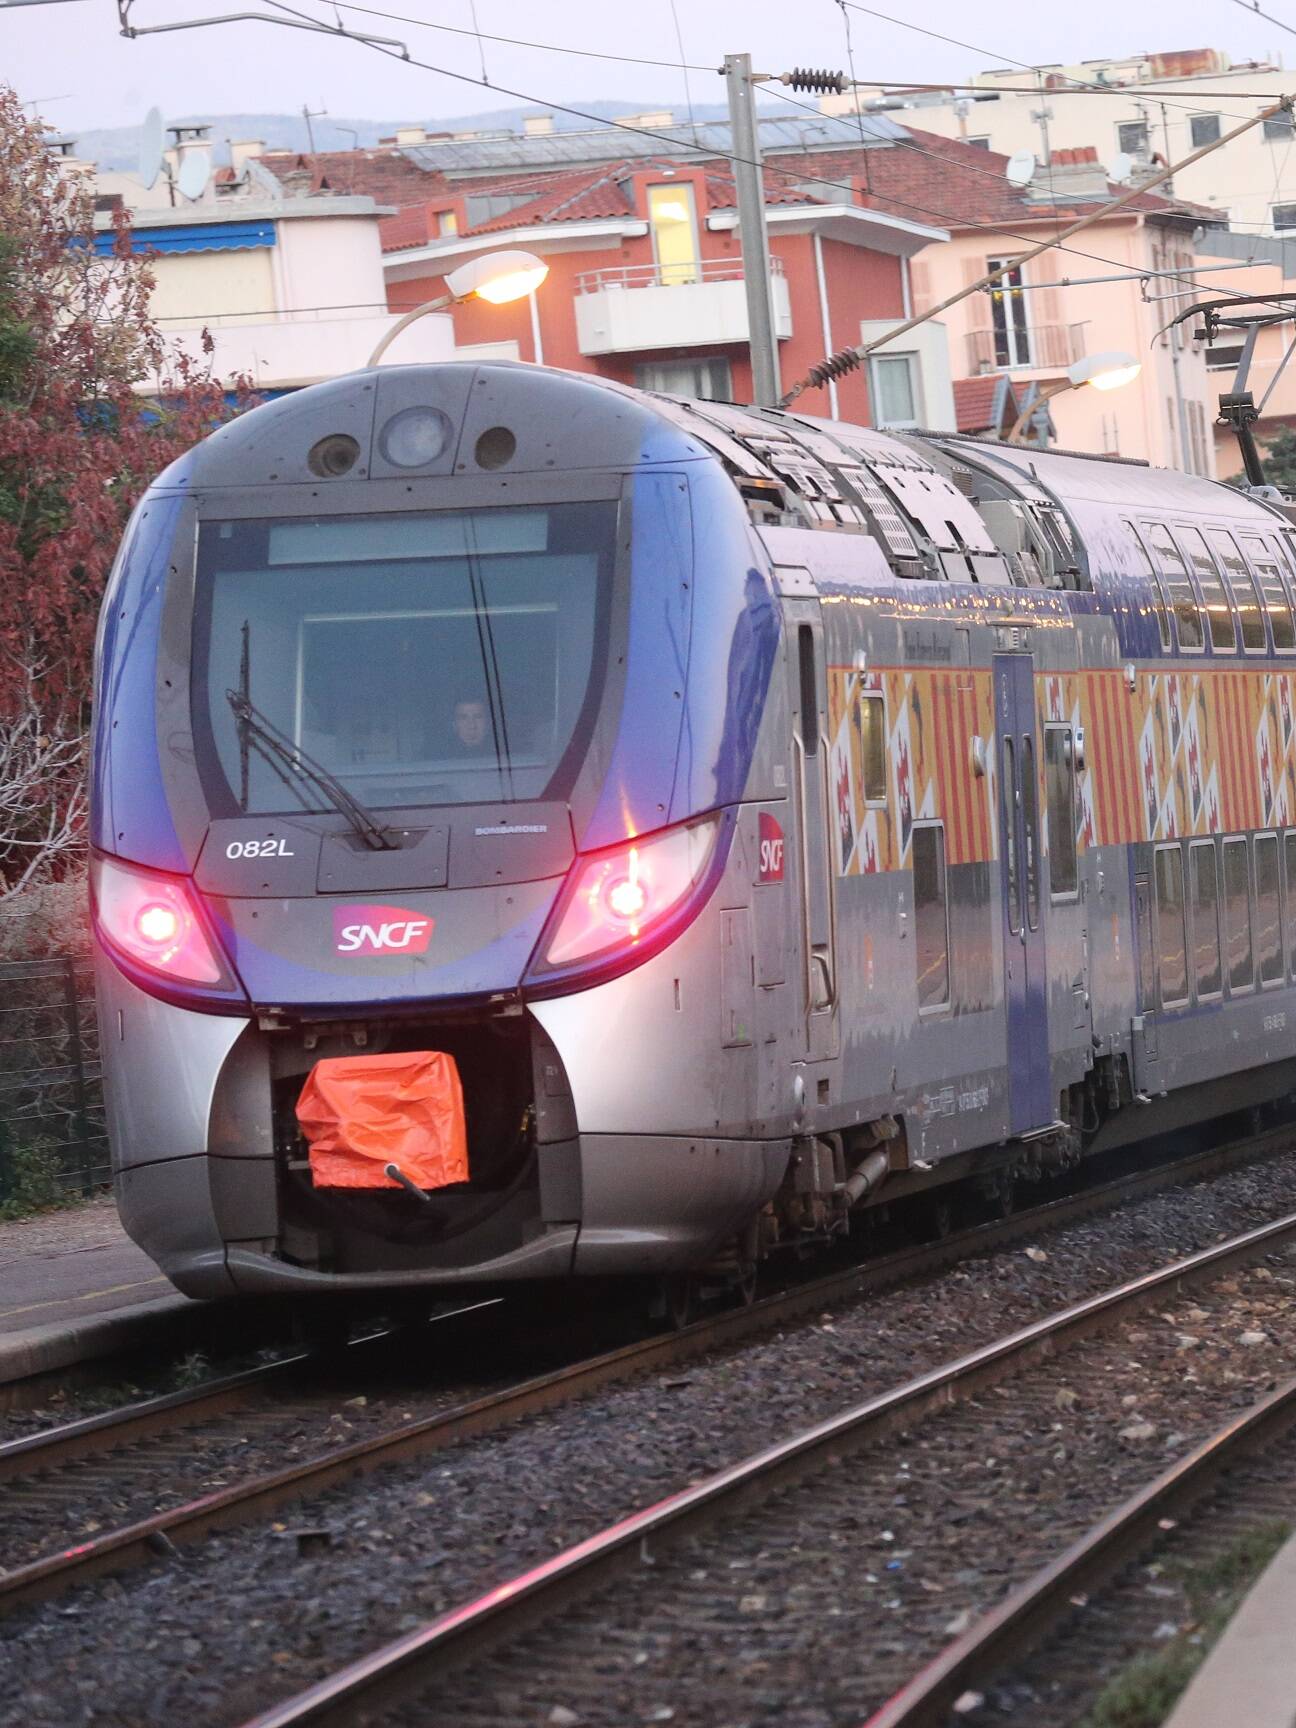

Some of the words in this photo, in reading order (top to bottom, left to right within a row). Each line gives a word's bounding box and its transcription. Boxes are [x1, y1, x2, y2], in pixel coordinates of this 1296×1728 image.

[226, 839, 295, 859] 082L
[760, 839, 783, 873] SNCF
[337, 921, 428, 951] SNCF
